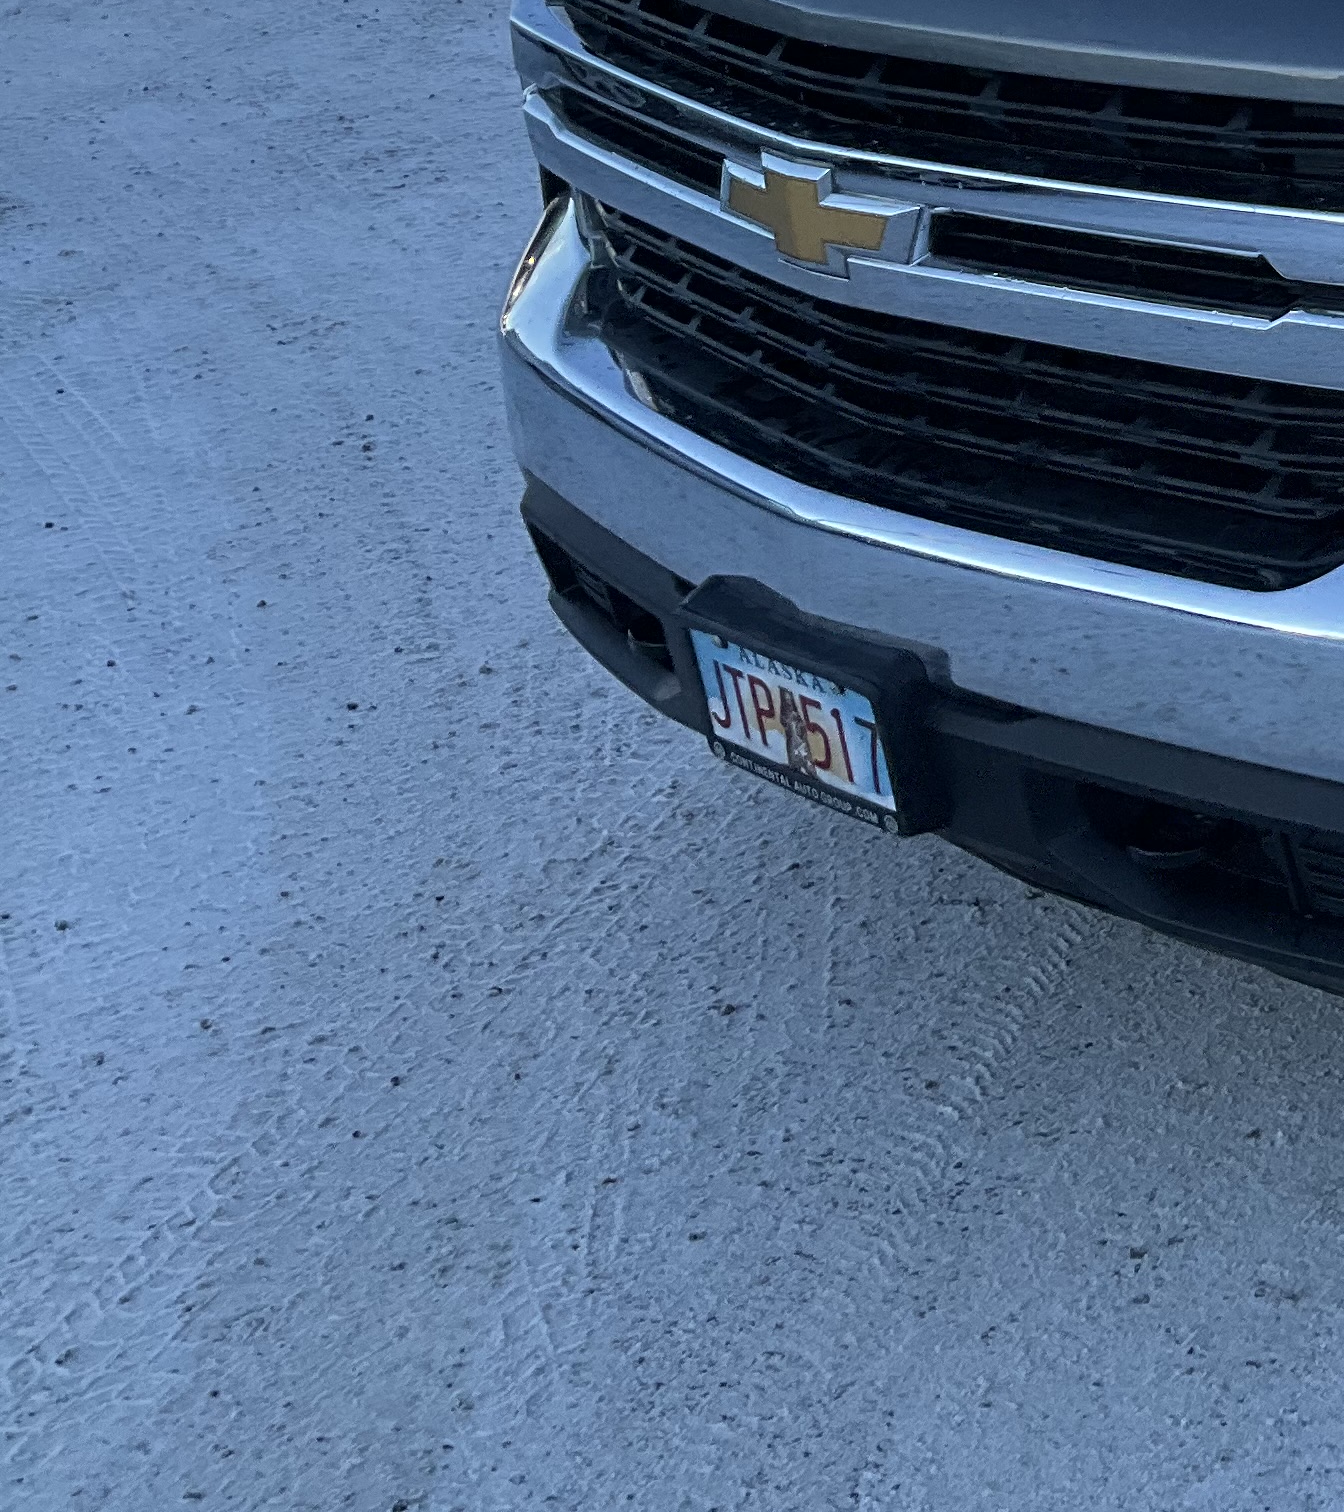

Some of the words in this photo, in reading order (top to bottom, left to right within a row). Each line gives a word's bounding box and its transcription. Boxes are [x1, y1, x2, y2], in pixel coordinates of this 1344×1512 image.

[740, 644, 827, 694] ALASKA
[711, 658, 776, 748] JTP
[794, 780, 819, 799] AUTO
[819, 791, 853, 813] GROUP
